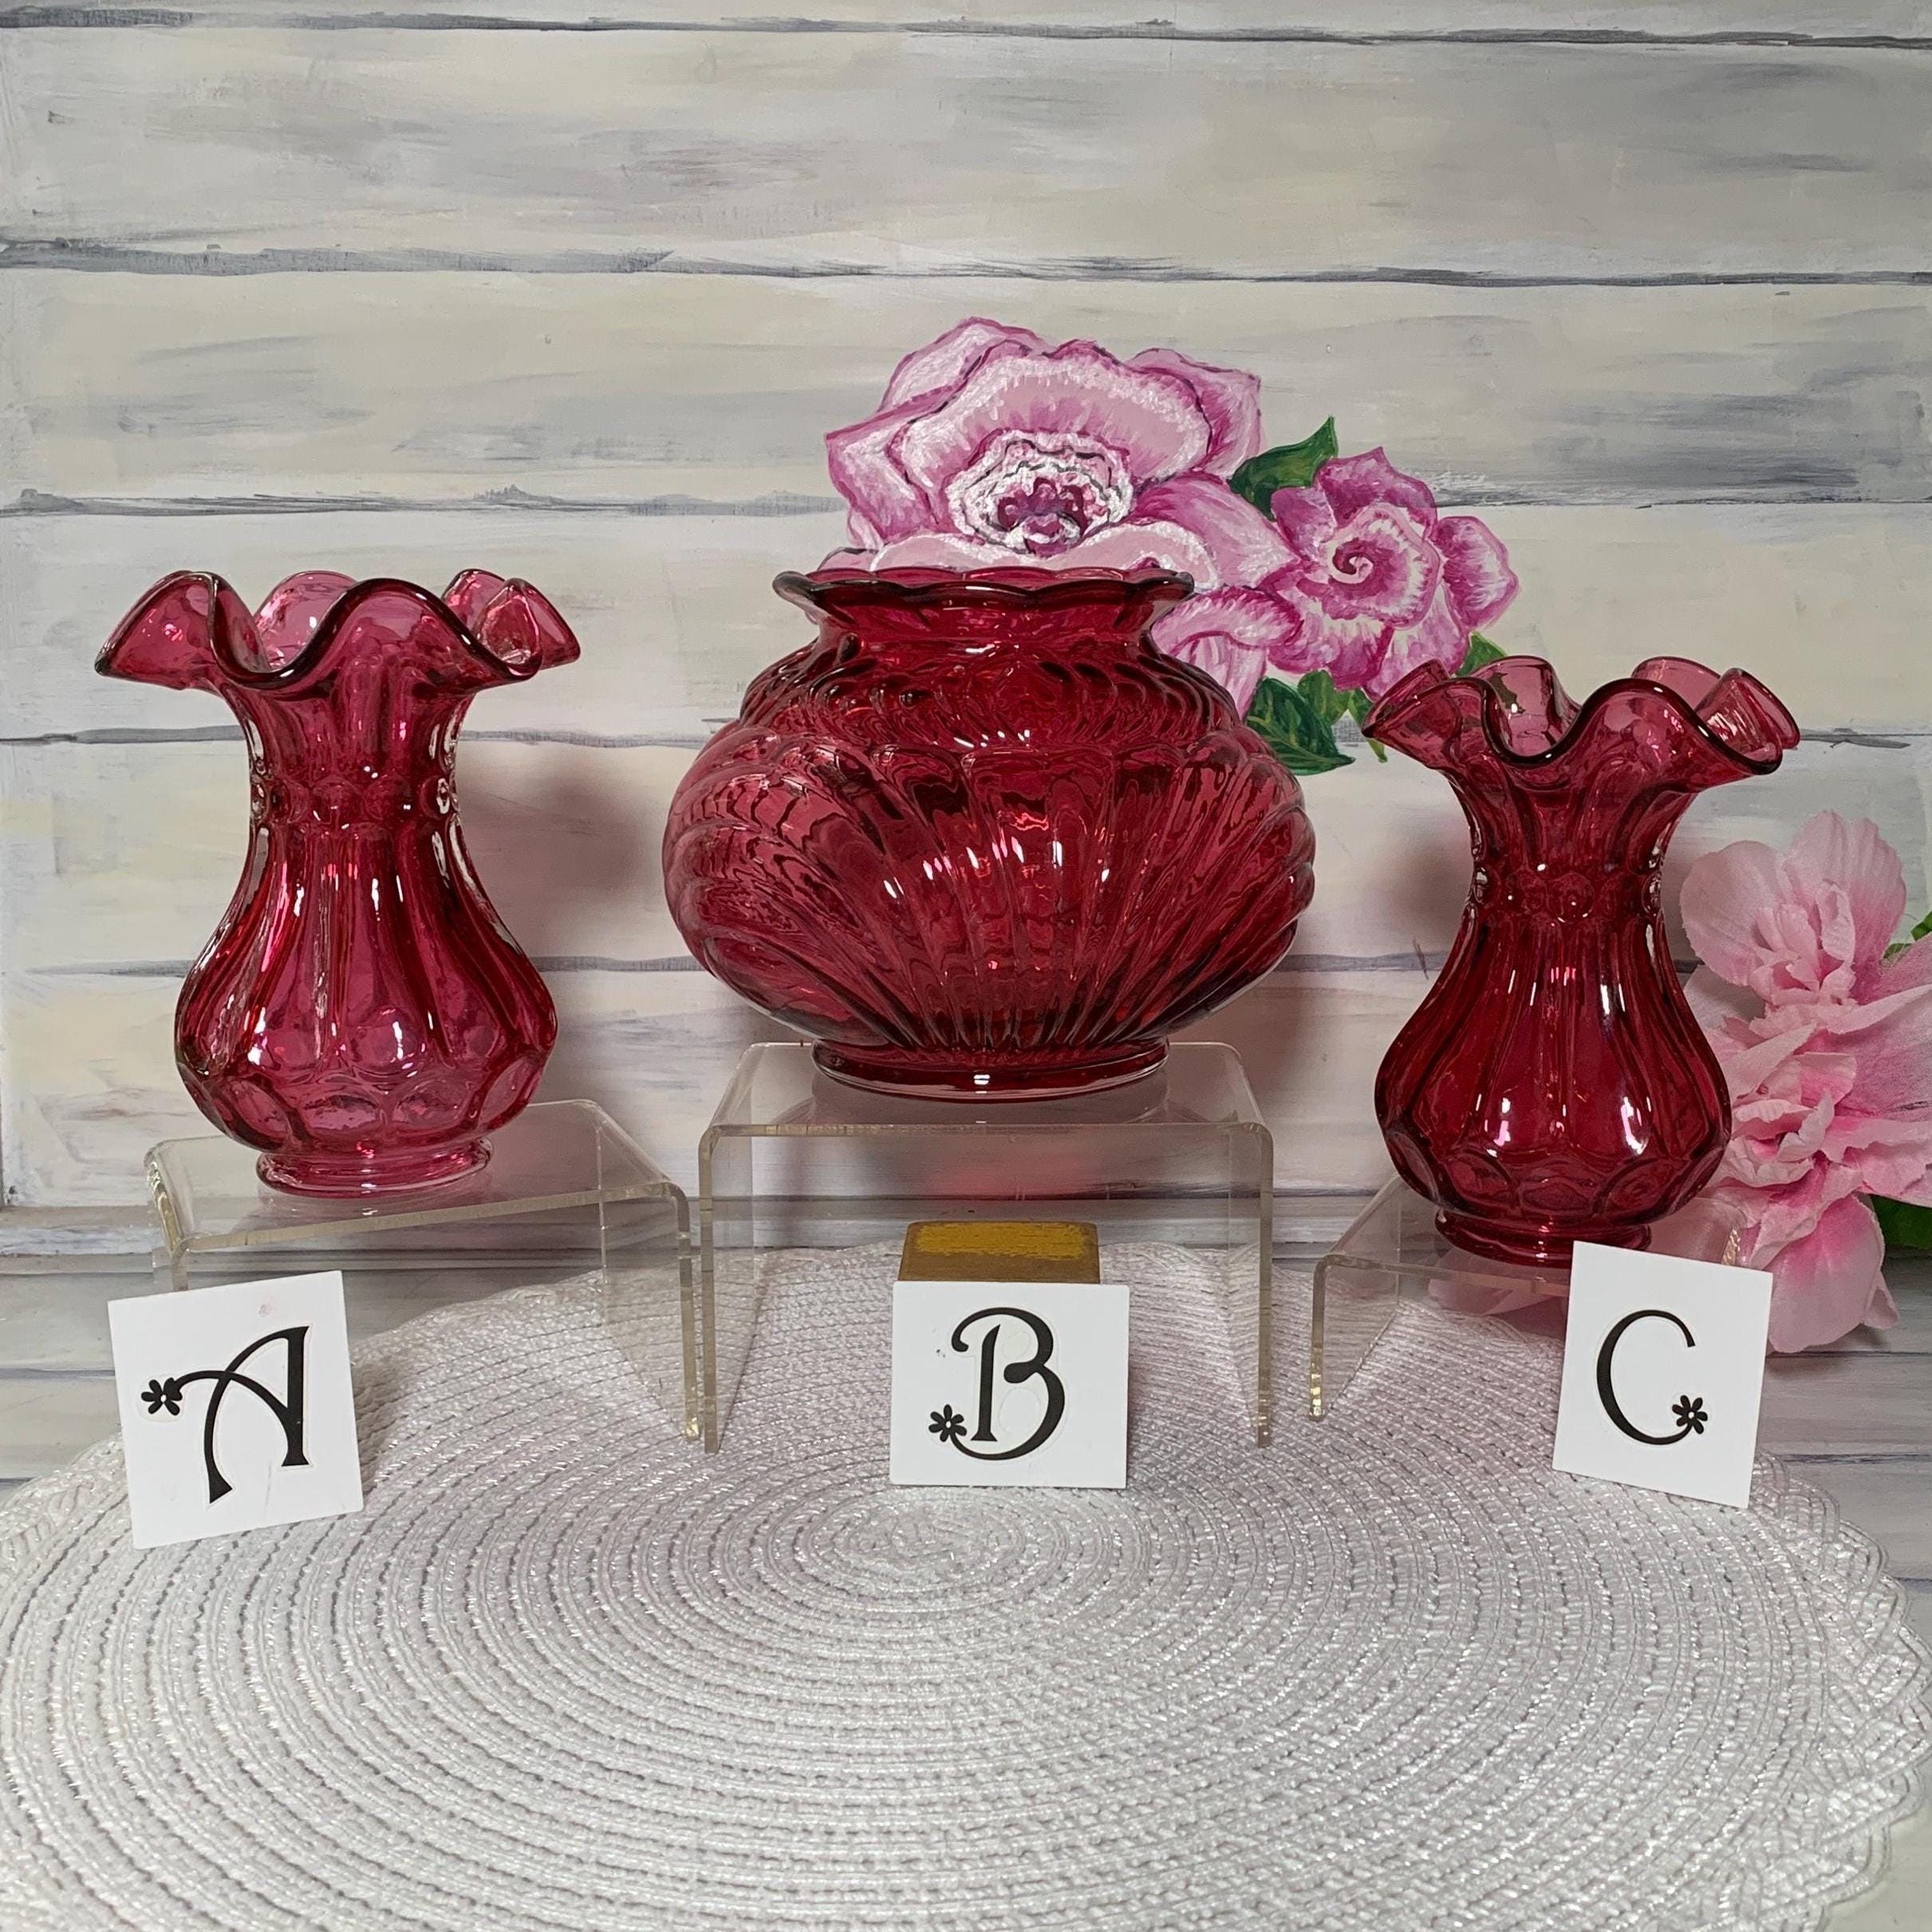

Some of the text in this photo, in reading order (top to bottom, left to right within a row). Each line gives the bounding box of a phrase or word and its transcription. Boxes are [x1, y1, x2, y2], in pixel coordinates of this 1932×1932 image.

[140, 1326, 310, 1504] A
[928, 1307, 1066, 1461] B
[1596, 1309, 1709, 1445] C
